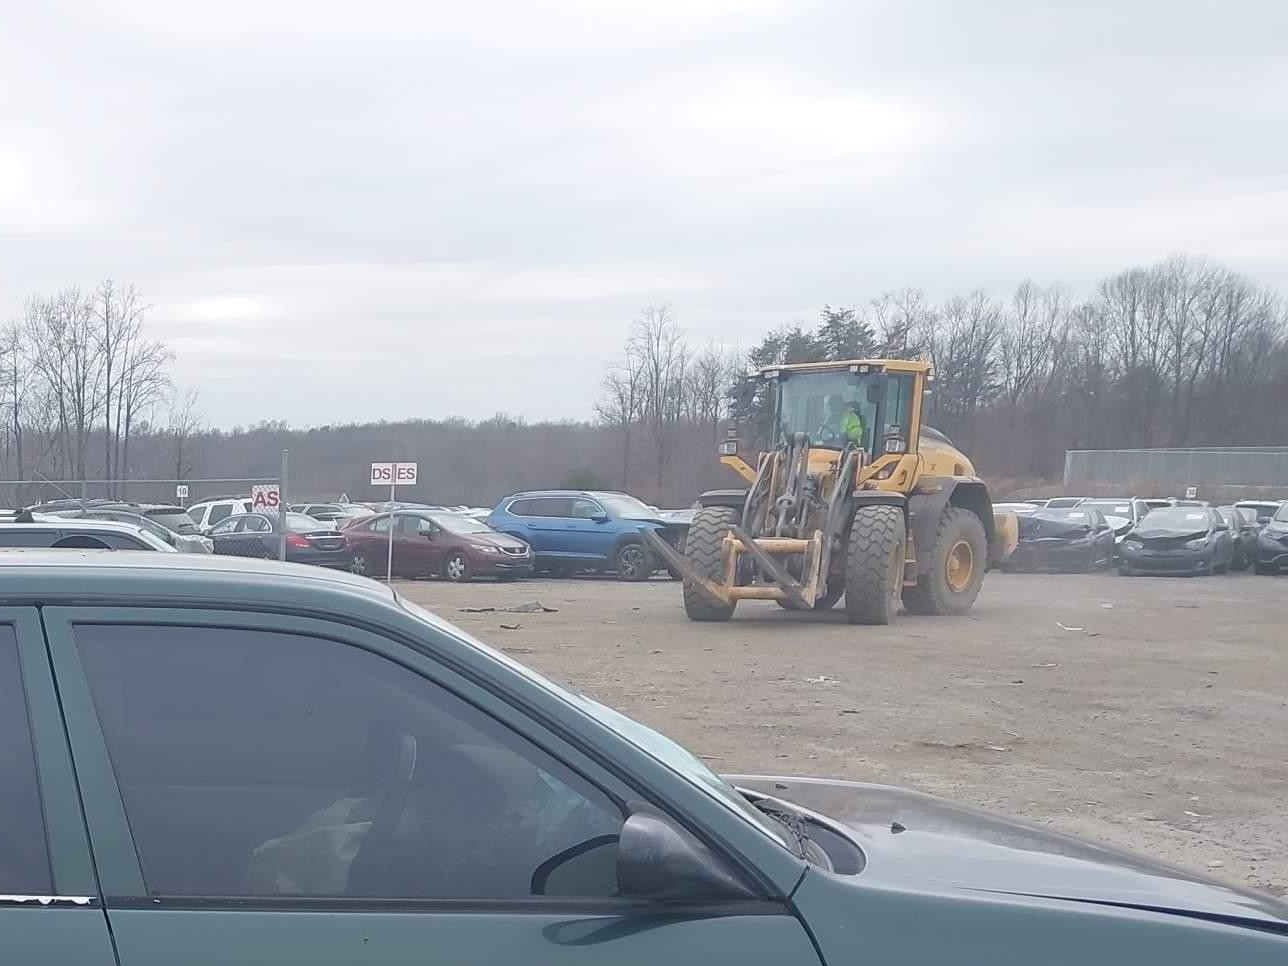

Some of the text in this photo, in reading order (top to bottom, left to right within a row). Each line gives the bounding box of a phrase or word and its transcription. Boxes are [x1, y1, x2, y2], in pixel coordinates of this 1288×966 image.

[372, 467, 415, 480] DS ES
[178, 486, 187, 496] 10
[254, 491, 279, 507] AS
